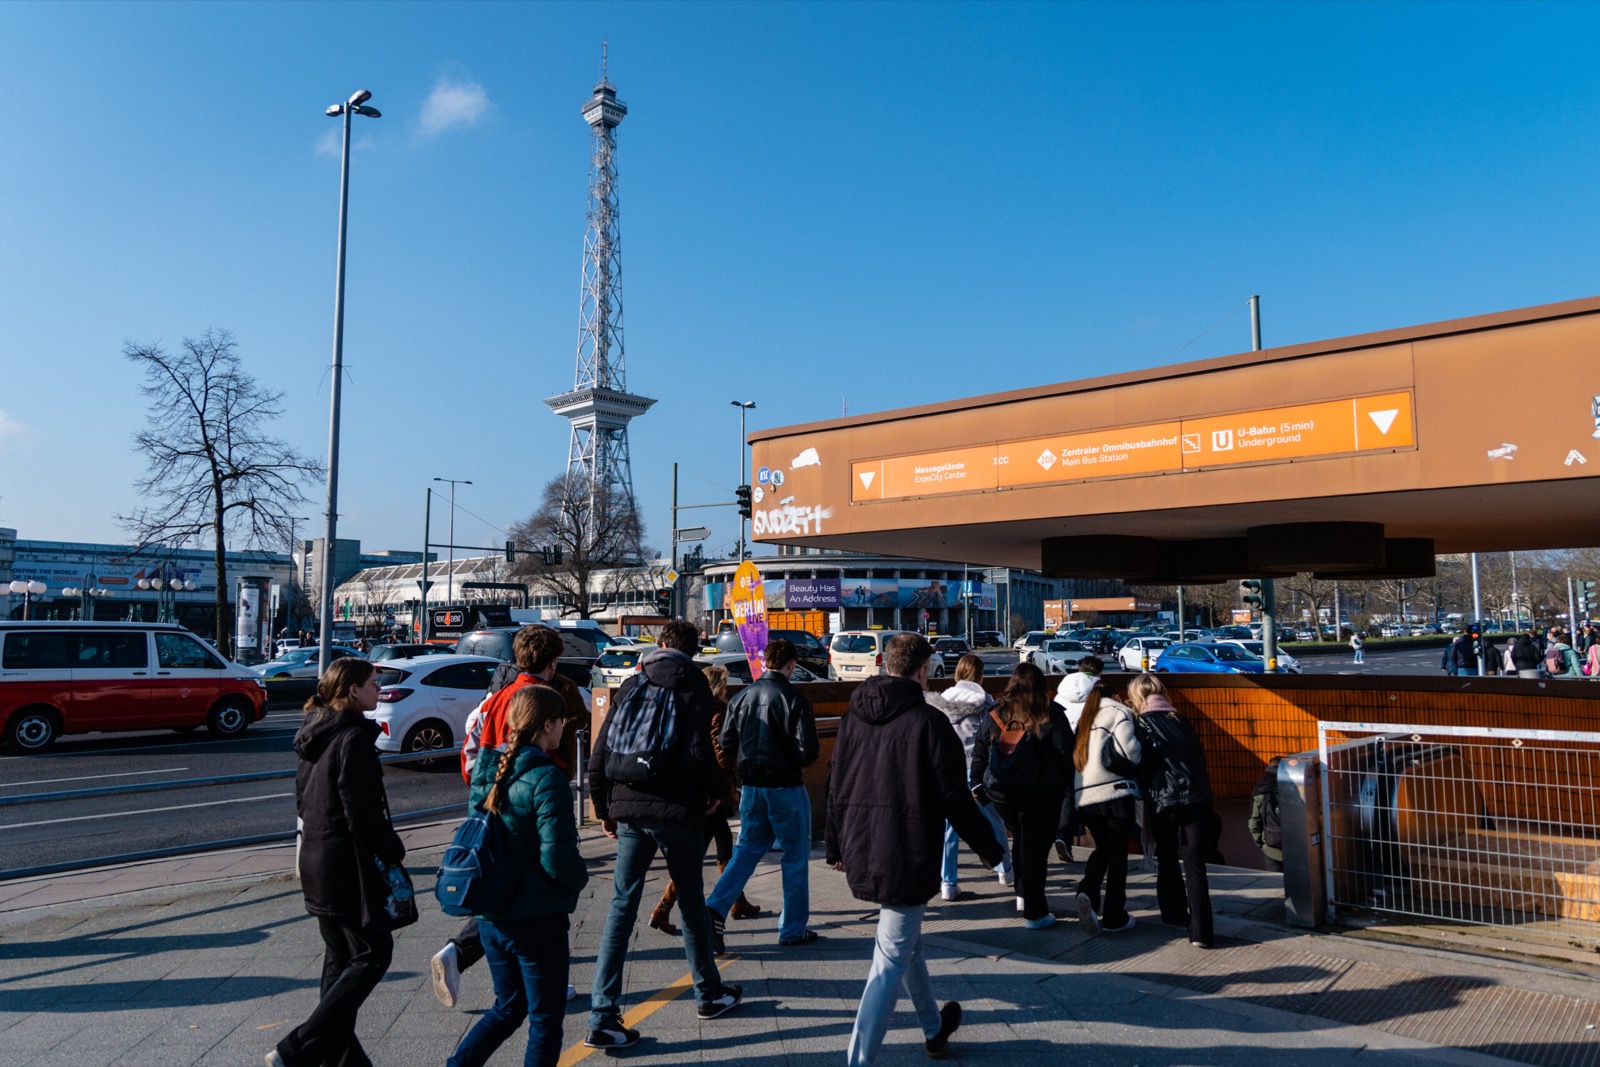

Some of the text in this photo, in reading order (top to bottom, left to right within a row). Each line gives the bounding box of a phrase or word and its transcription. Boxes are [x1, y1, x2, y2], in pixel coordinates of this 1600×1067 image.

[1238, 426, 1276, 437] U-Bahn
[1062, 436, 1178, 457] Zentraler Omnibusbahnhof
[1215, 432, 1231, 449] U
[1238, 433, 1301, 448] Underground
[993, 456, 1009, 465] ICC
[1062, 453, 1129, 467] Main Bus Station
[914, 462, 965, 475] Messegelände
[914, 471, 968, 483] ExpoCity Center
[789, 584, 836, 593] Beauty Has
[789, 595, 837, 603] An Address
[734, 600, 764, 618] BERLIN
[749, 612, 764, 624] LIVE
